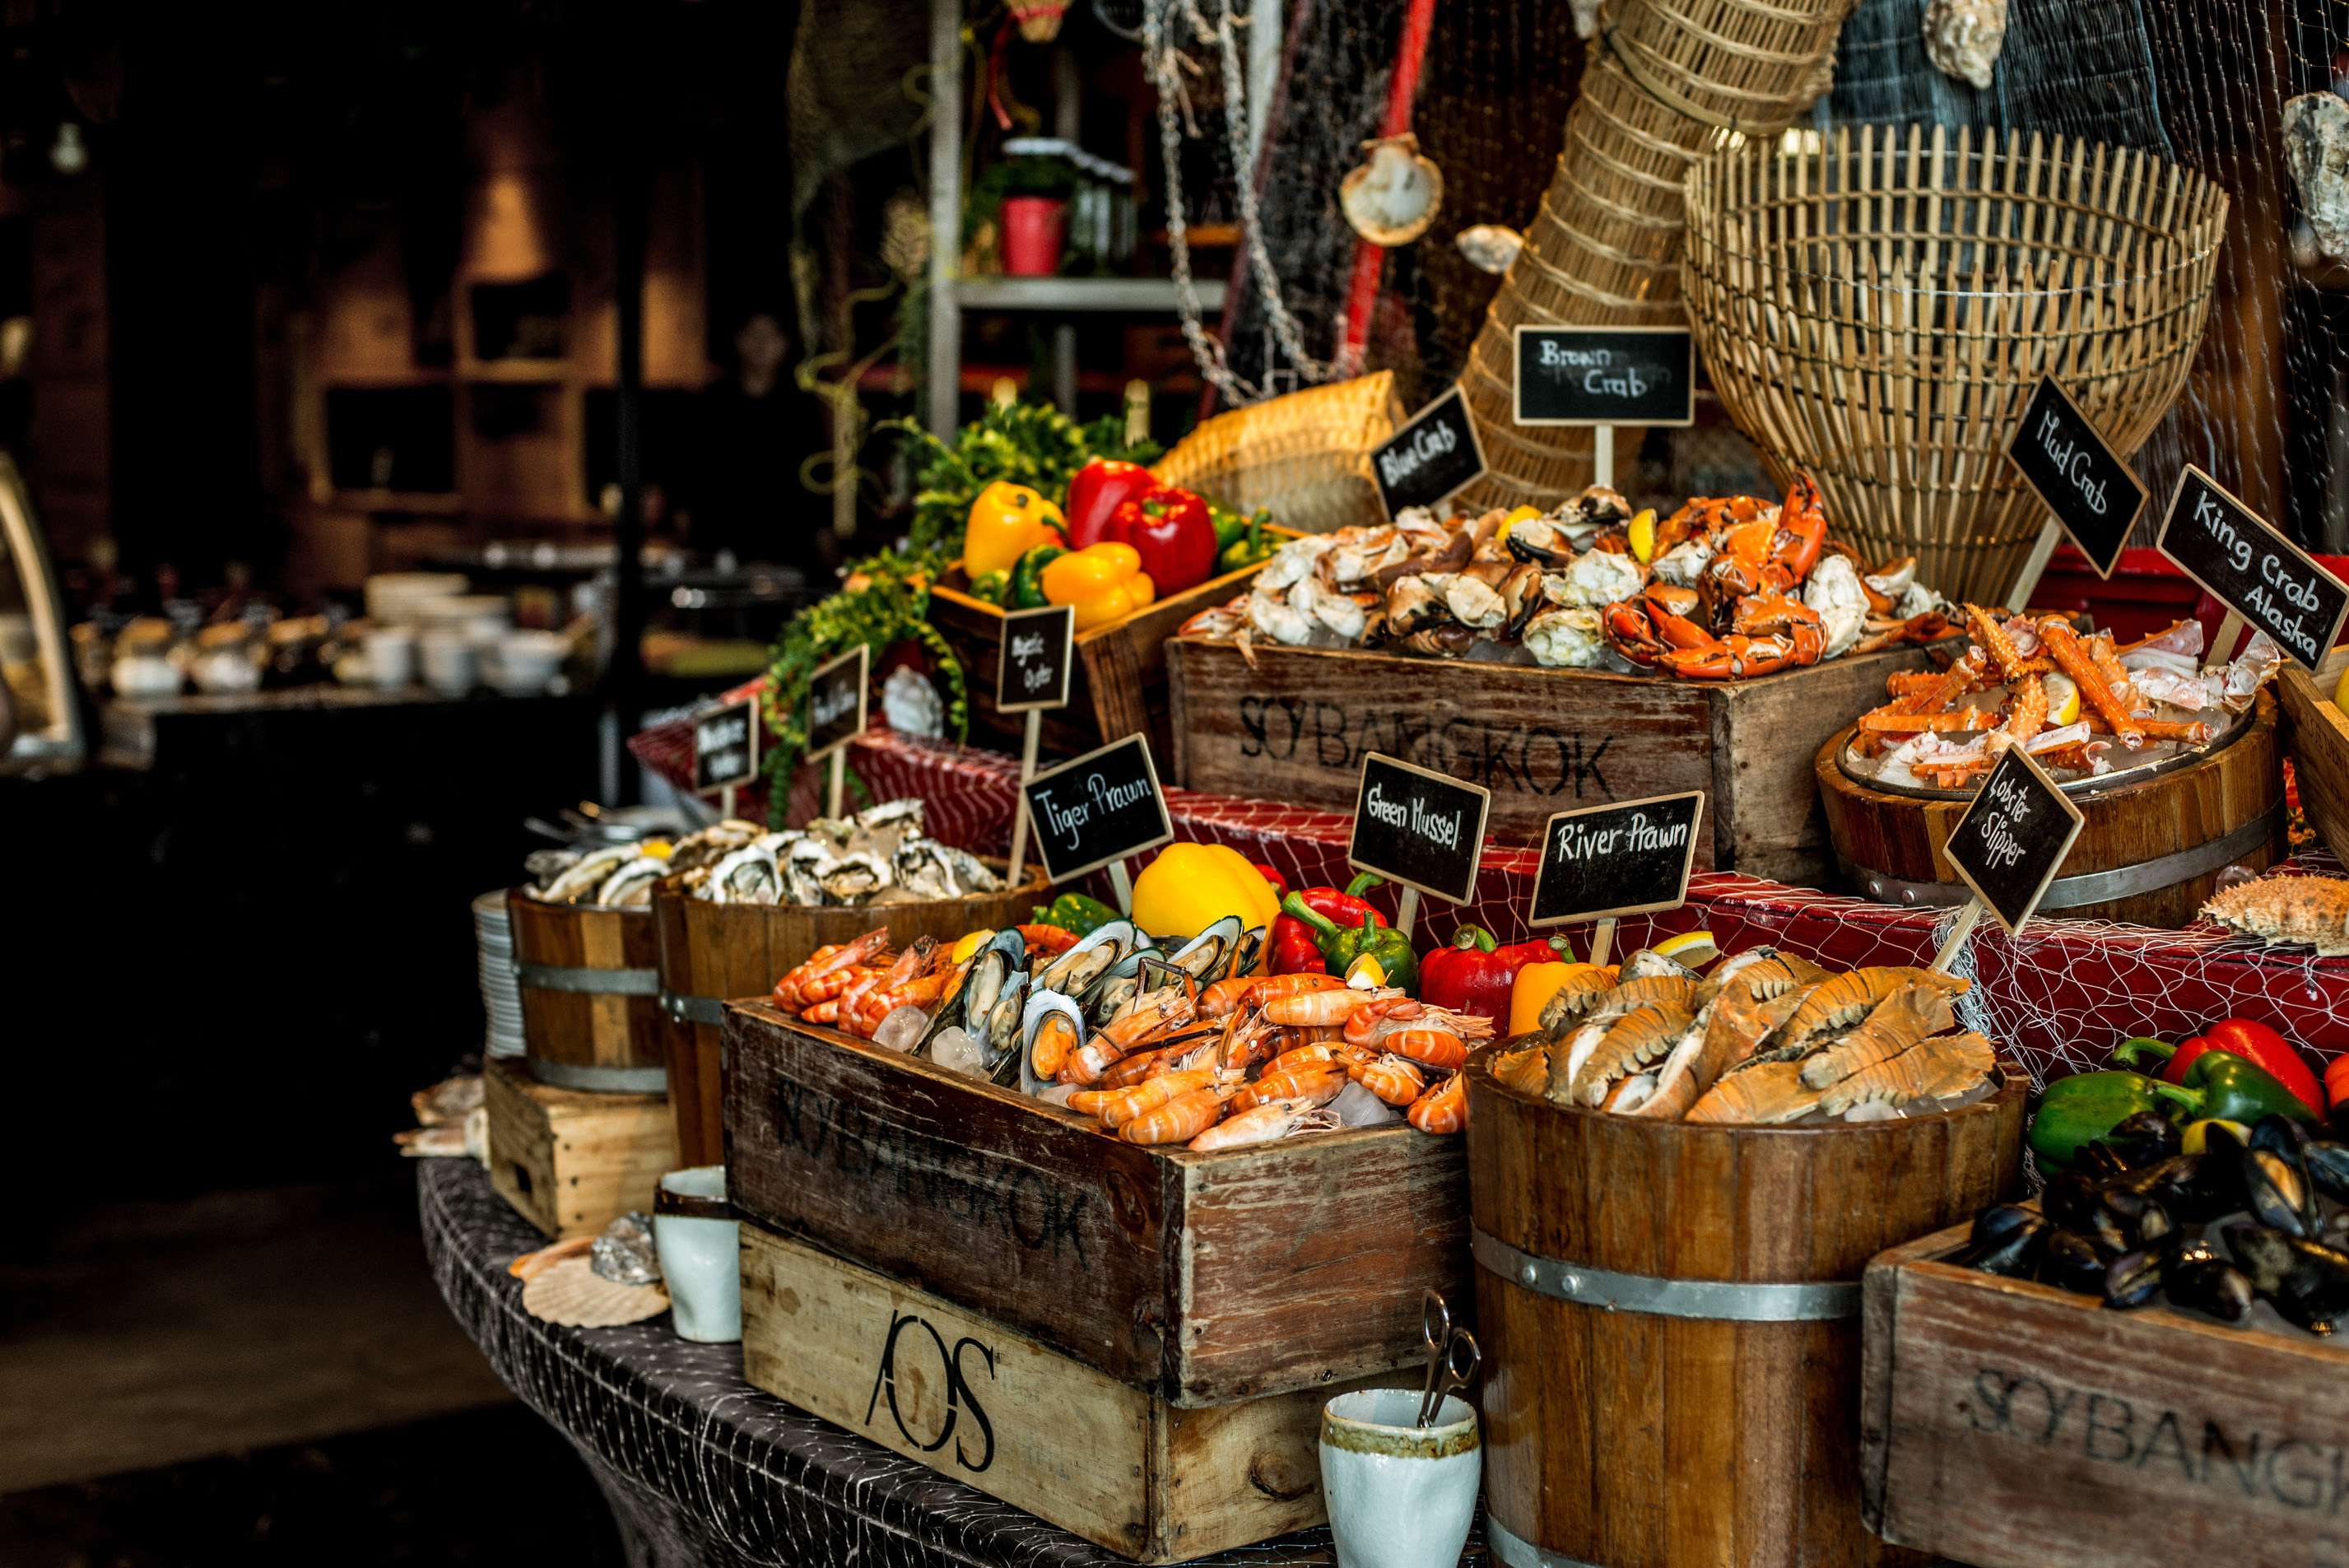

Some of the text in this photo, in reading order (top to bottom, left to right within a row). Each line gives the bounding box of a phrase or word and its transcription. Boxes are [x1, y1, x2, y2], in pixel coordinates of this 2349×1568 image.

[1540, 340, 1611, 366] Brown
[1584, 367, 1647, 398] Crab
[1380, 420, 1458, 486] Blue Crab
[2037, 410, 2107, 514] Mud Crab
[2194, 490, 2319, 612] King Crab
[2245, 585, 2317, 660] Alaska
[1034, 773, 1152, 850] Tiger Prawn
[1367, 782, 1461, 851] Green Mussel
[1989, 761, 2031, 823] Lobster
[1557, 812, 1687, 863] River Prawn
[1980, 812, 2026, 870] Slipper
